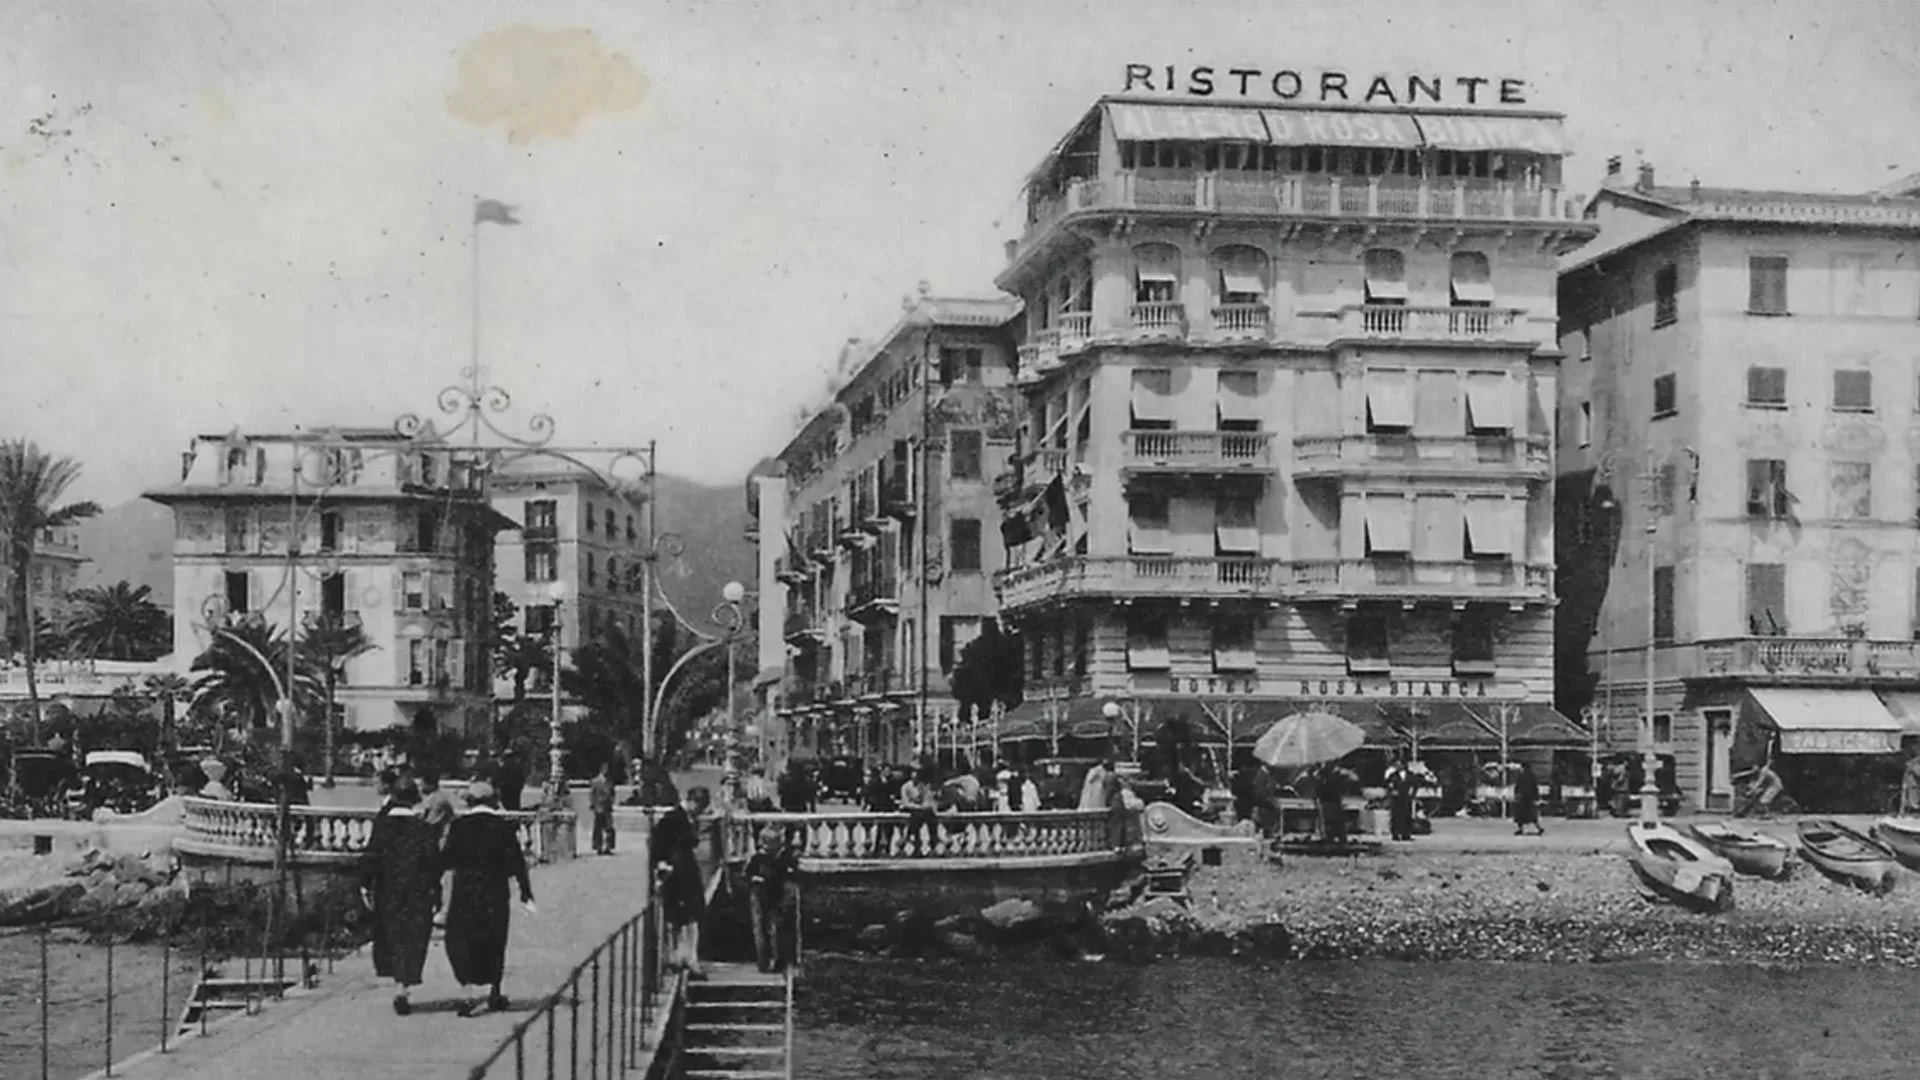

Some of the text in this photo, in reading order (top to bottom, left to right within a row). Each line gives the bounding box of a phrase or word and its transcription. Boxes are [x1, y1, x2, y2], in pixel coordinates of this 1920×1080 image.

[1124, 64, 1527, 104] RISTORANTE
[1303, 113, 1406, 143] ROSA
[1169, 678, 1487, 697] HOTEL ROSA BIANCA
